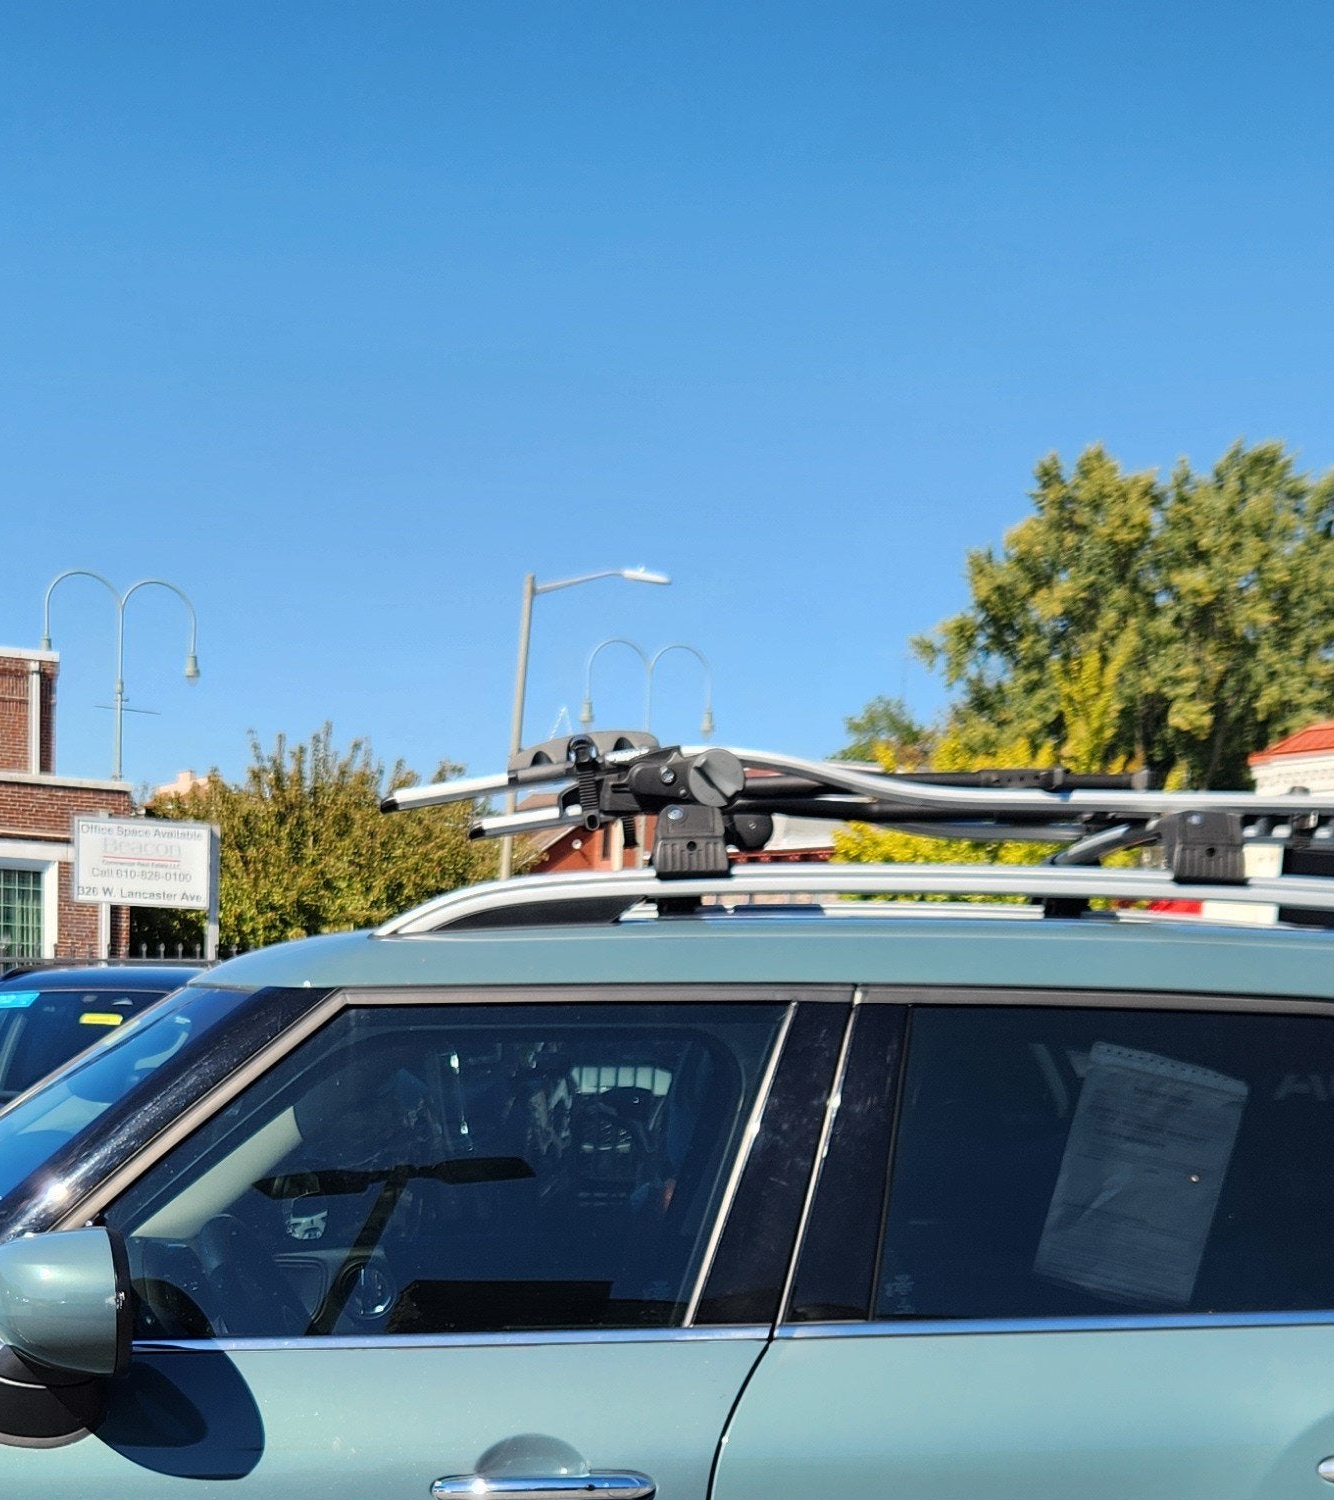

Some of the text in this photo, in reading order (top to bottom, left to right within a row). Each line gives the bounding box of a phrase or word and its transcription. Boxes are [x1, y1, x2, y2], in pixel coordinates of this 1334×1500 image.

[80, 824, 203, 841] Office Space Available
[102, 838, 181, 857] Beacon
[91, 867, 113, 878] Call
[120, 889, 178, 901] Lancaster
